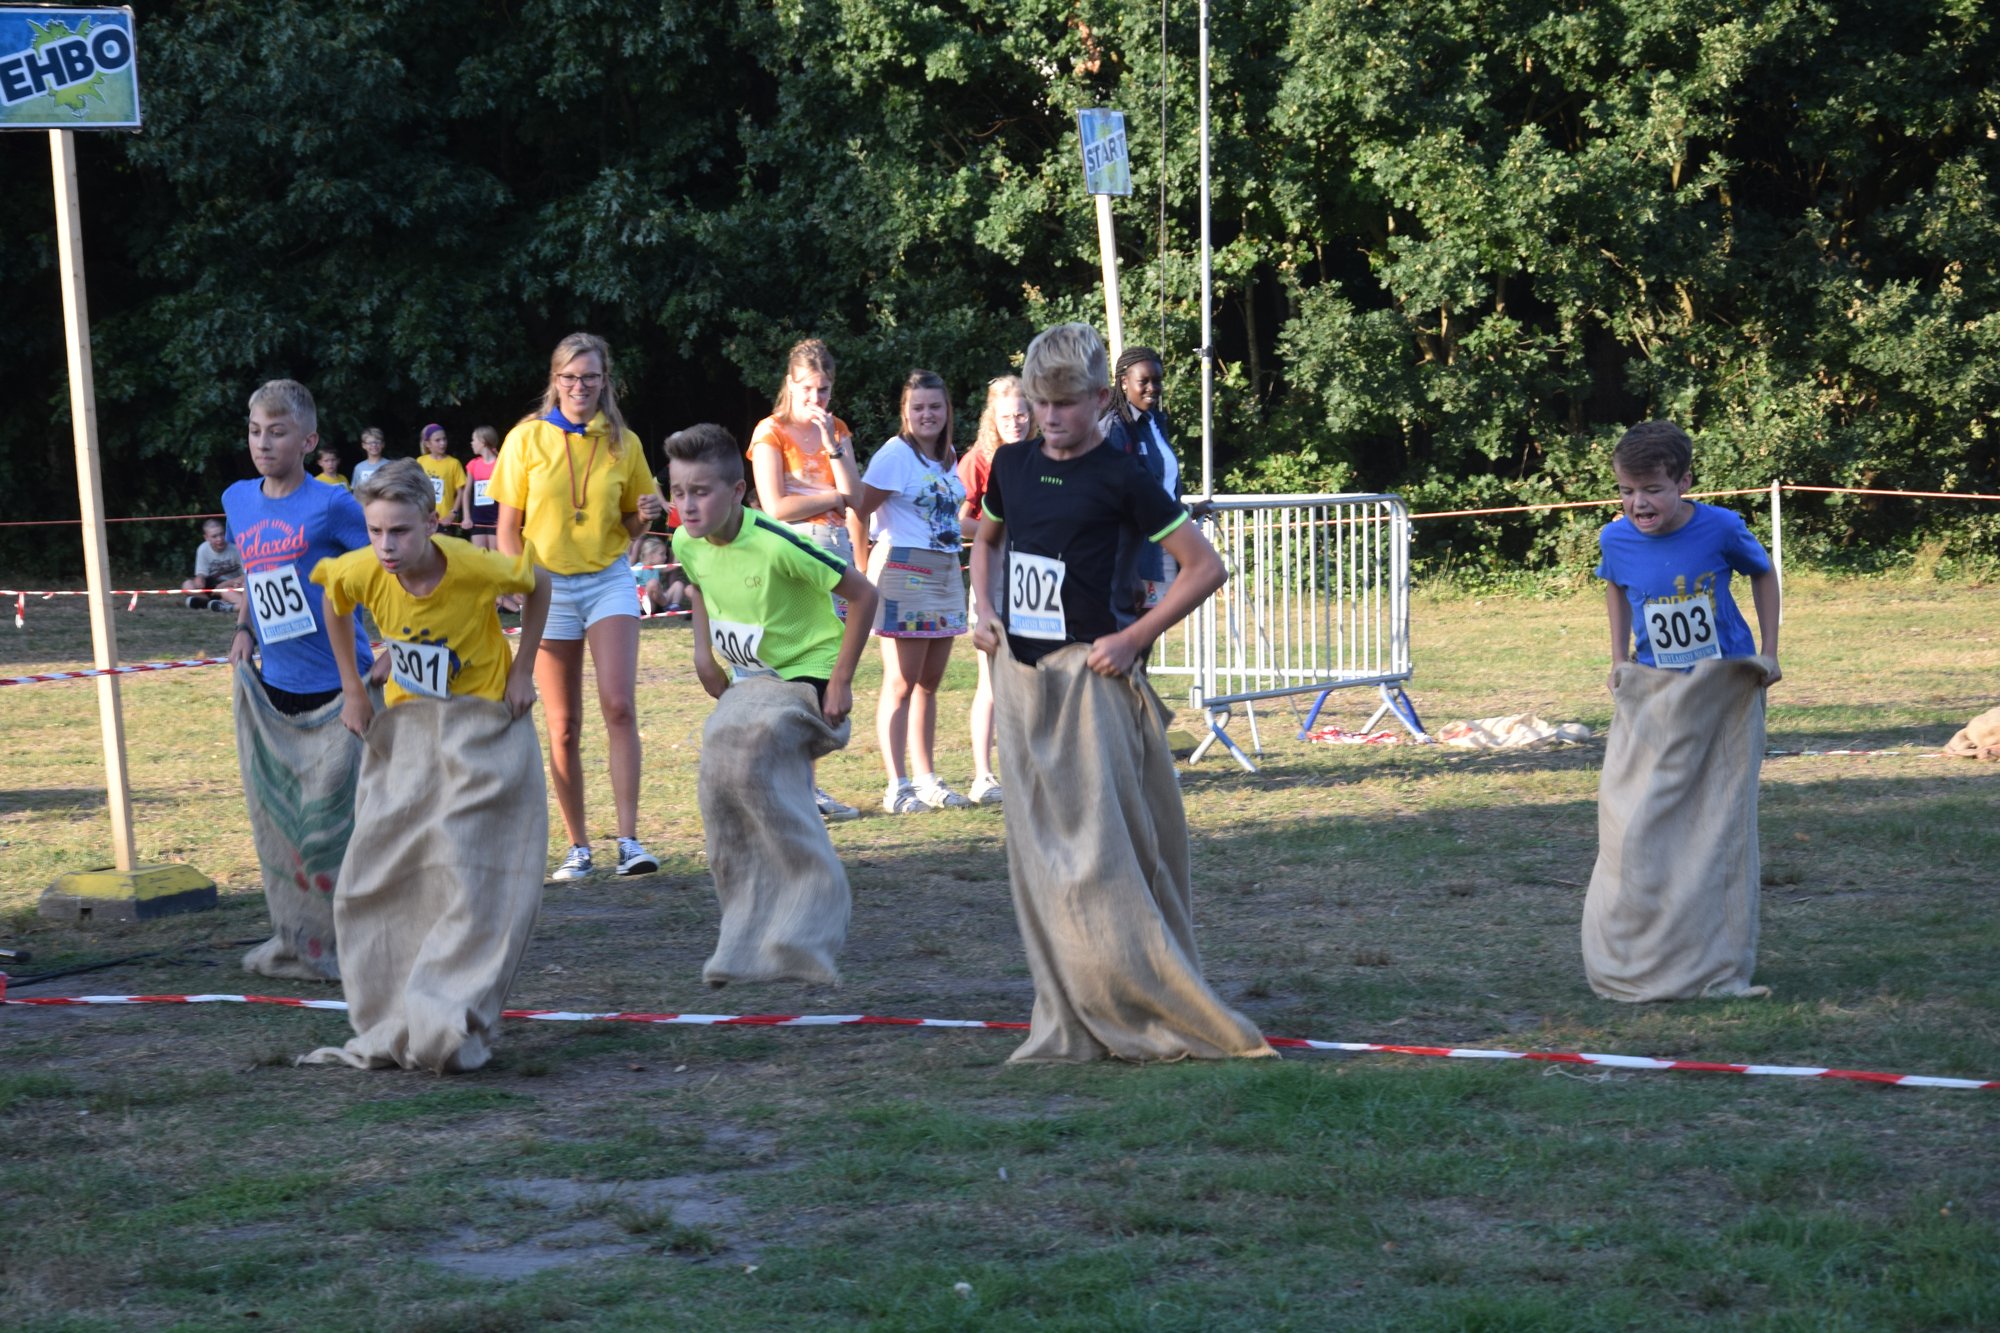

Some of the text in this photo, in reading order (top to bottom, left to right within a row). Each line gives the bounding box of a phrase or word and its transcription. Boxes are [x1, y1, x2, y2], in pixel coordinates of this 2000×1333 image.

[0, 28, 131, 103] EHBO
[1086, 132, 1125, 173] START
[235, 523, 305, 560] Relaxed
[254, 575, 303, 620] 305
[744, 575, 763, 588] CR
[1013, 562, 1060, 612] 302
[715, 629, 764, 668] 304
[1651, 605, 1711, 649] 303
[391, 643, 440, 692] 301
